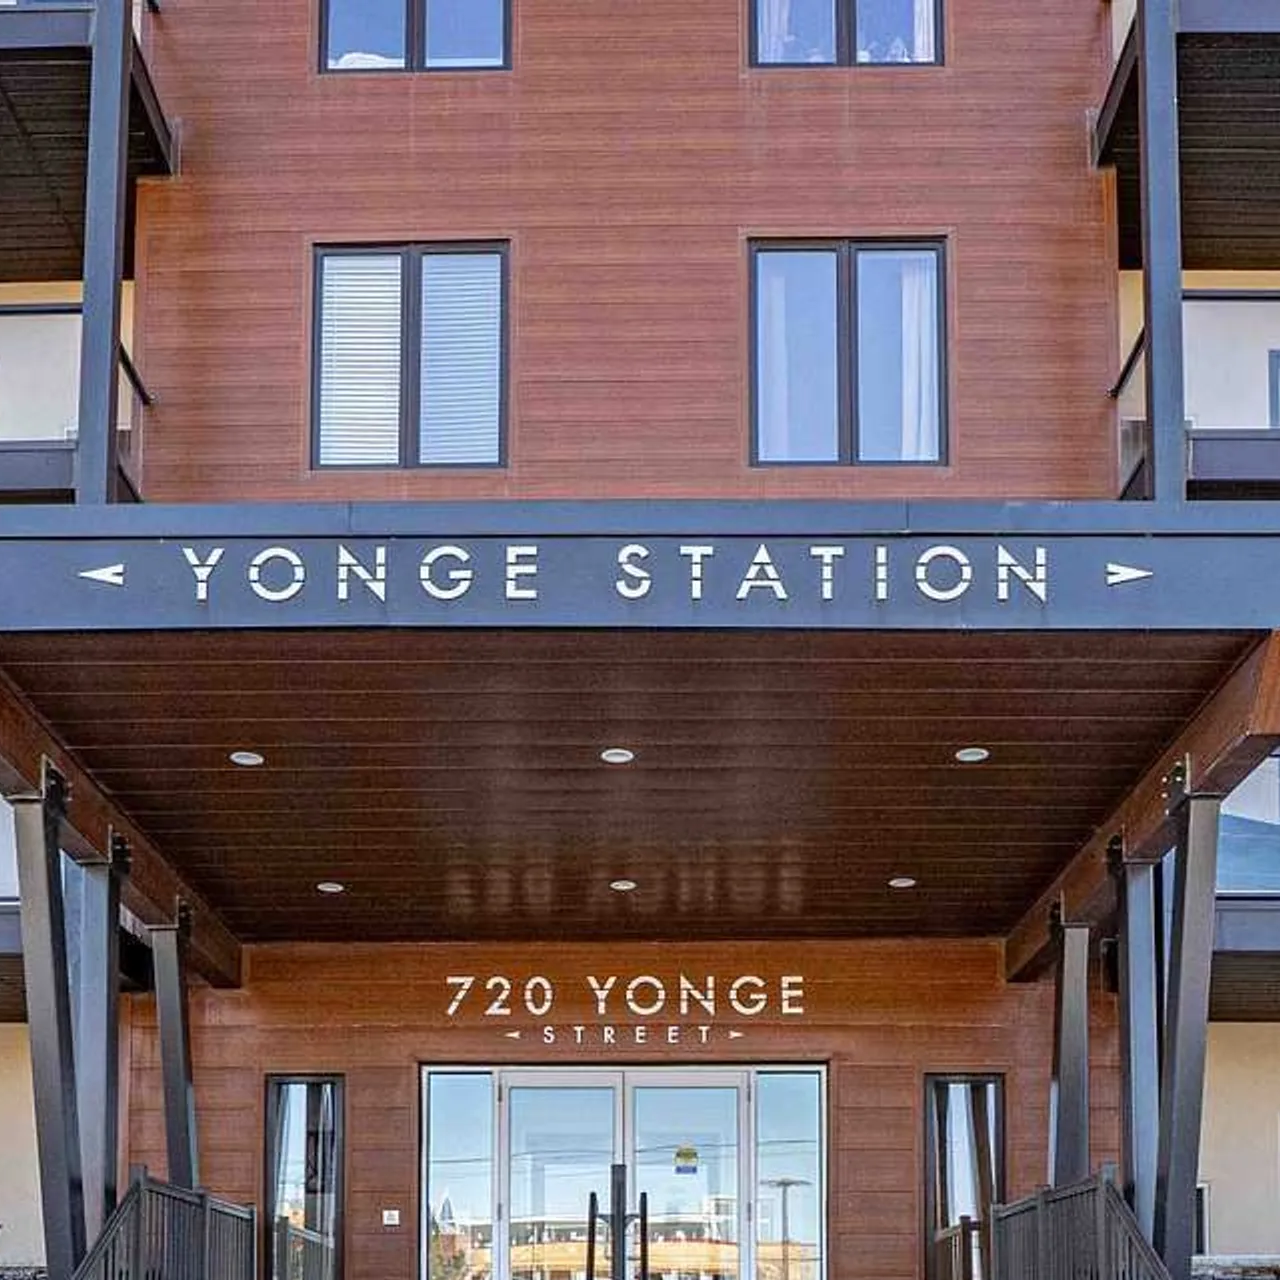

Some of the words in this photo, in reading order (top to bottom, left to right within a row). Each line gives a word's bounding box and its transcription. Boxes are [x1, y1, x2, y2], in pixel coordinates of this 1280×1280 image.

[181, 545, 539, 601] YONGE
[616, 544, 1048, 601] STATION
[446, 976, 553, 1015] 720
[587, 976, 804, 1015] YONGE
[543, 1026, 710, 1043] STREET
